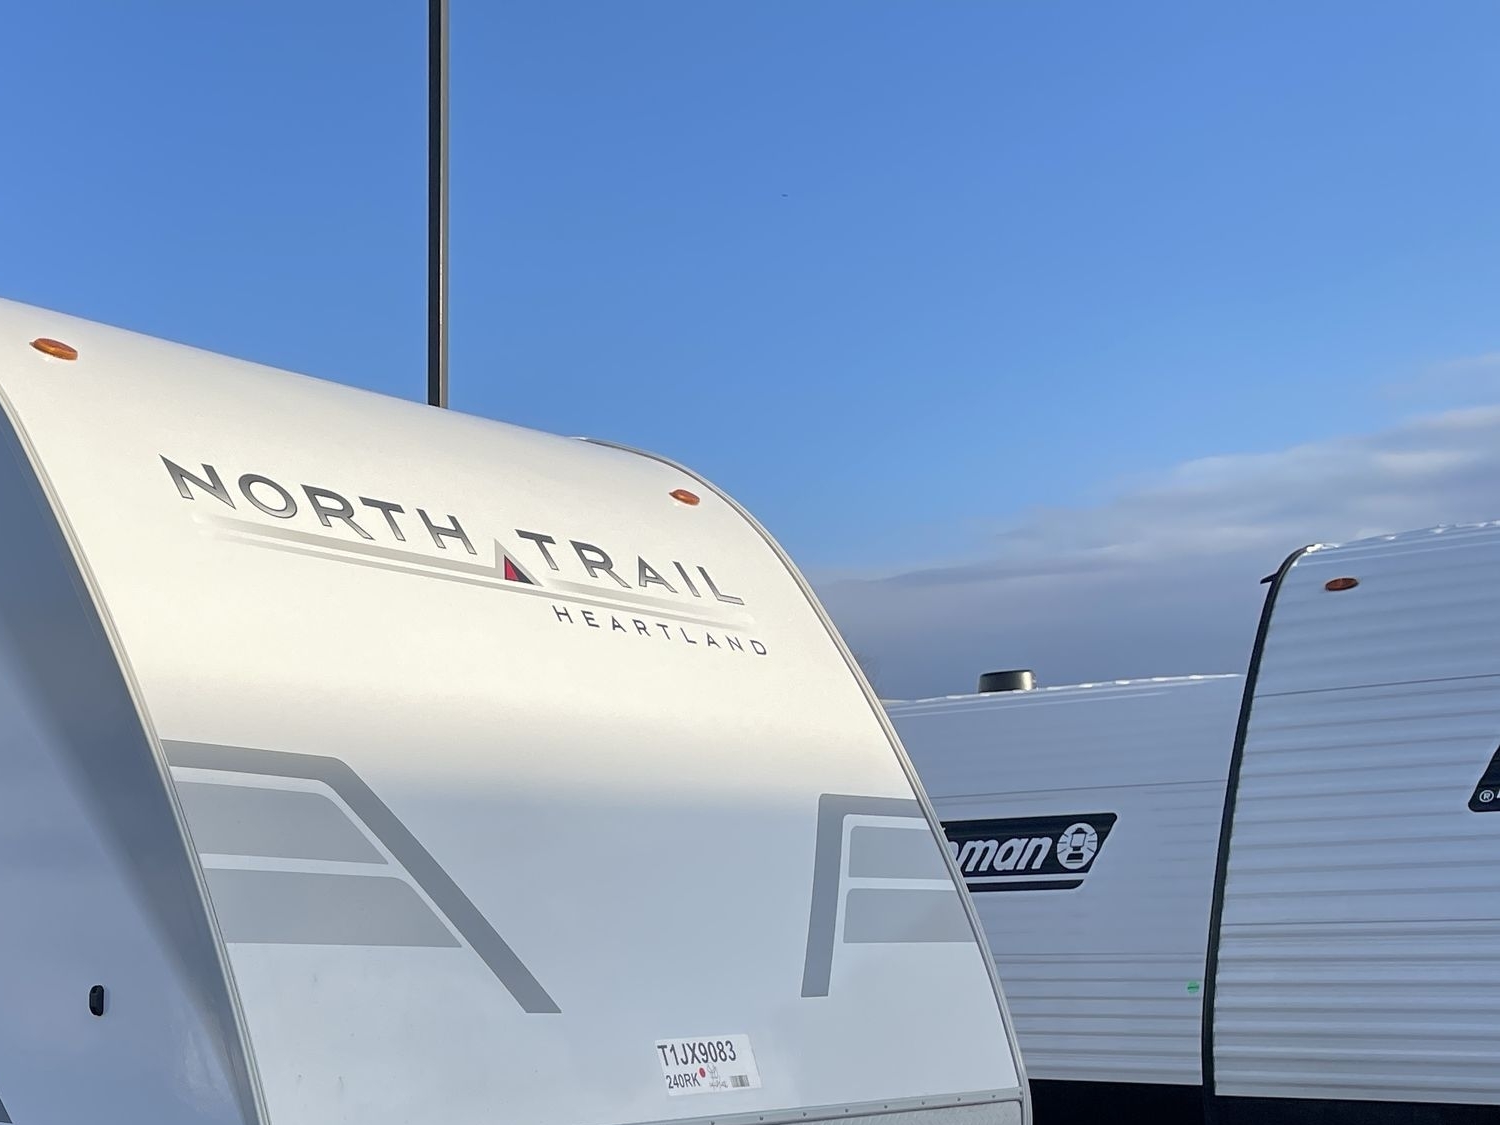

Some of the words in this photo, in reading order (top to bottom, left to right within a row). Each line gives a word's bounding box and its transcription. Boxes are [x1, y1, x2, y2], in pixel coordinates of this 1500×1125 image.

[159, 454, 478, 556] NORTH
[515, 528, 745, 606] TRAIL
[552, 604, 768, 657] HEARTLAND
[948, 836, 1053, 873] man
[657, 1040, 737, 1066] T1JX9083
[666, 1073, 701, 1089] 240RK
